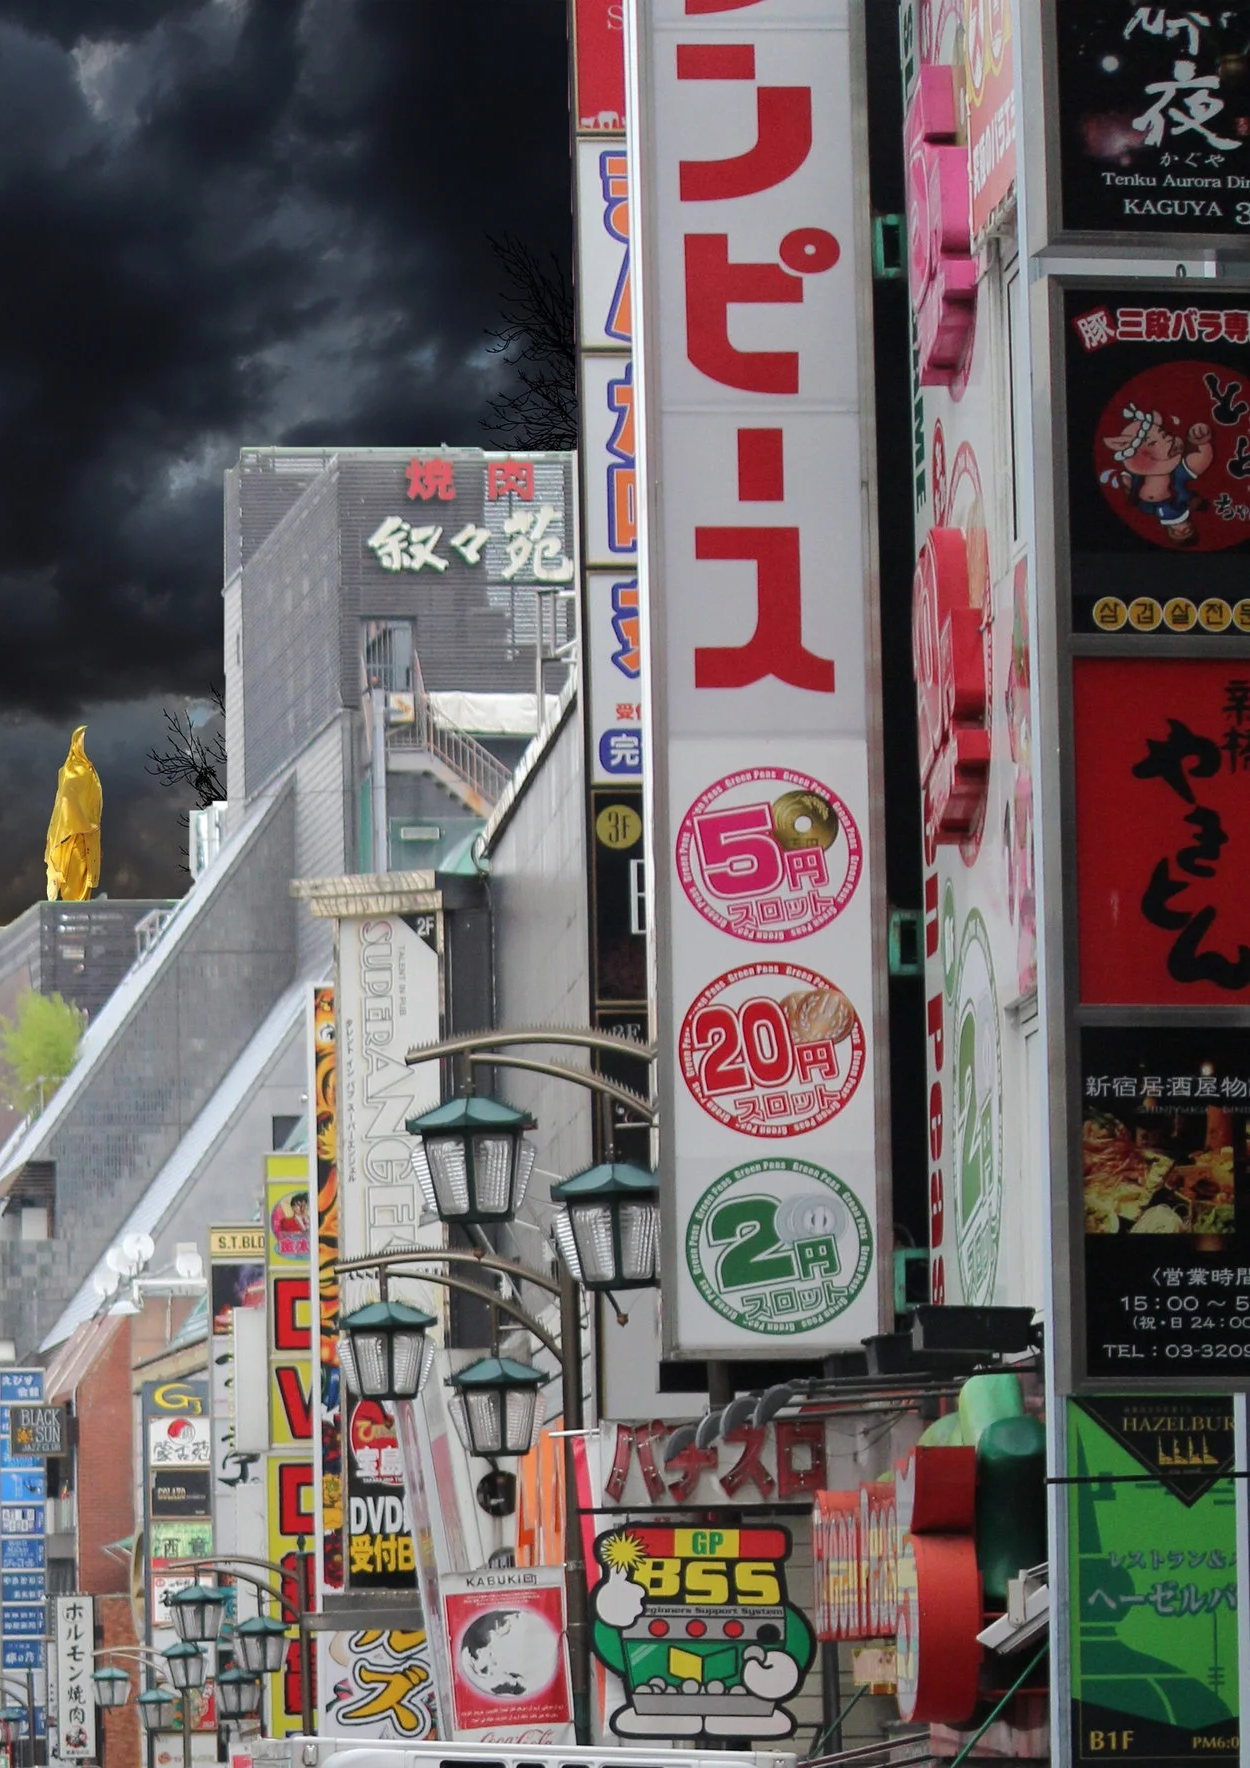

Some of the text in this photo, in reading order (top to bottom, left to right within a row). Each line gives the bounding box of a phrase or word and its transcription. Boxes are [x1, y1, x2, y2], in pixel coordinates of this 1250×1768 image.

[1160, 152, 1225, 168] かぐや
[1102, 172, 1222, 188] Tenku Aurora
[1124, 199, 1223, 217] KAGUYA
[676, 0, 841, 693] ンピース
[1078, 313, 1114, 349] 豚
[406, 458, 535, 501] 焼肉
[367, 505, 575, 584] 叙々苑
[607, 811, 632, 844] 3F
[692, 801, 830, 900] 5円
[1131, 718, 1250, 990] やきとん
[417, 917, 436, 937] 2F
[726, 890, 837, 929] スロット
[691, 996, 840, 1098] 20円
[734, 1084, 841, 1122] スロット
[1085, 1075, 1250, 1098] 新宿居酒屋物
[705, 1193, 841, 1294] 2円
[740, 1280, 851, 1320] スロット
[21, 1408, 60, 1426] BLACK
[36, 1426, 61, 1443] SUN
[605, 1420, 827, 1503] パチスロ
[692, 1531, 724, 1556] GP
[633, 1558, 783, 1606] BSS
[741, 1607, 783, 1618] System
[64, 1602, 88, 1725] ホルモン焼肉
[1090, 1730, 1135, 1751] B1F
